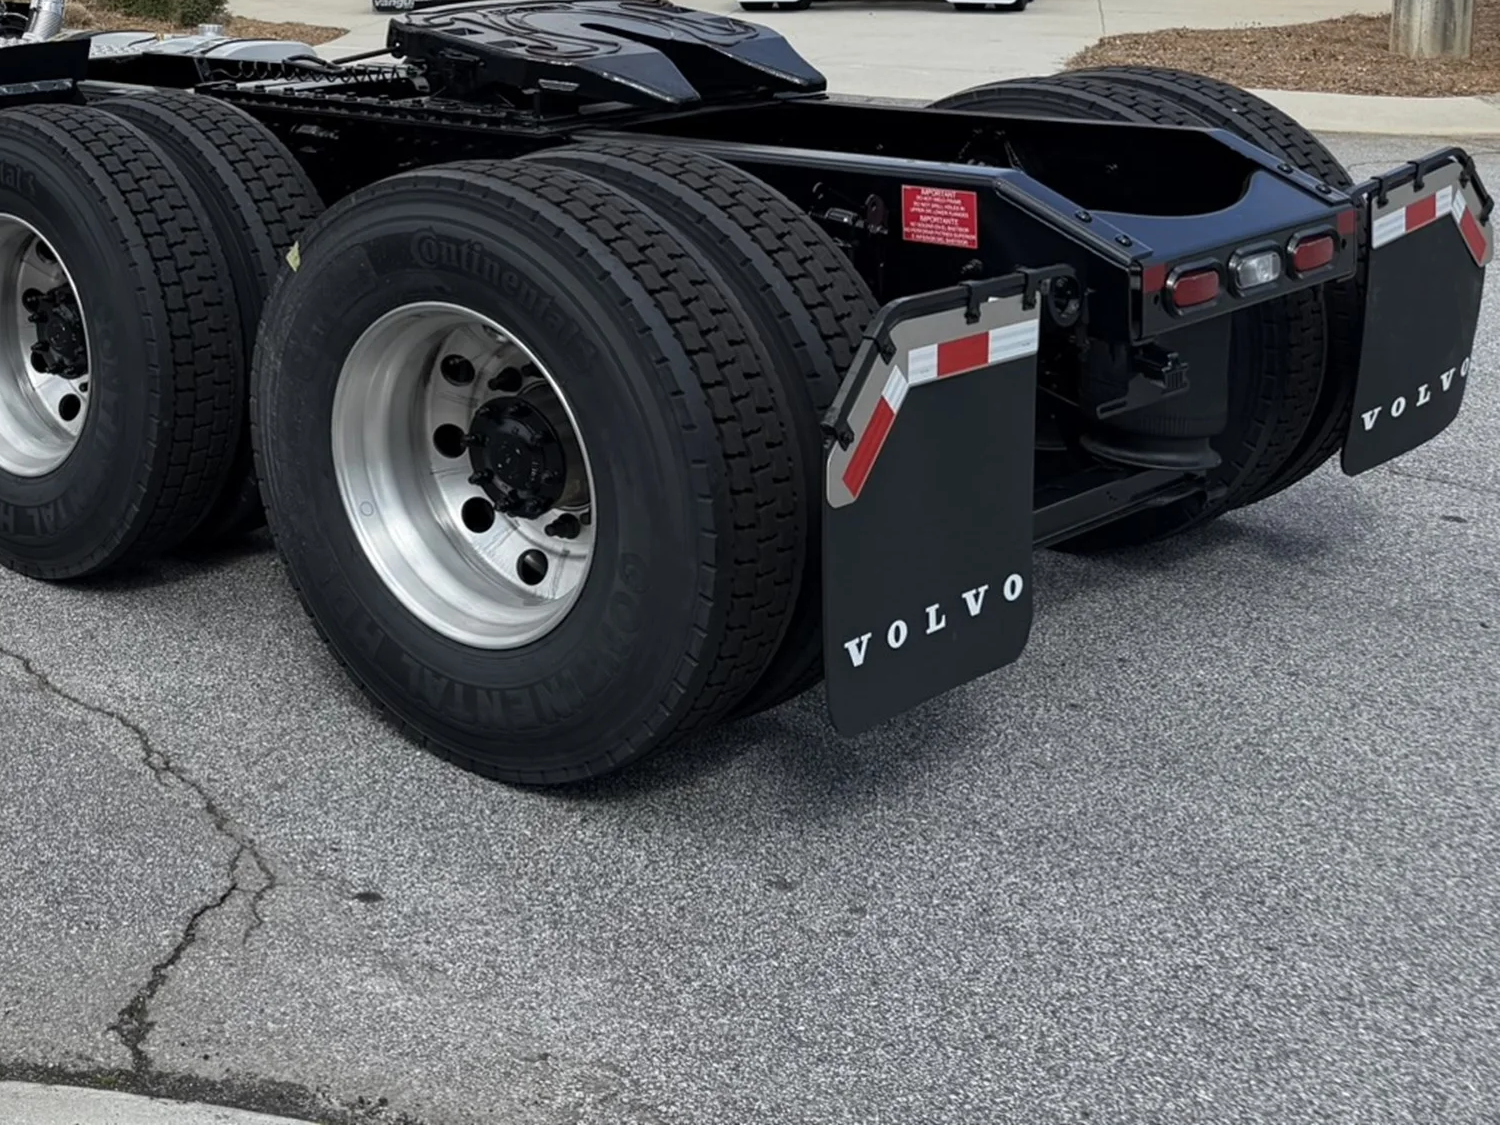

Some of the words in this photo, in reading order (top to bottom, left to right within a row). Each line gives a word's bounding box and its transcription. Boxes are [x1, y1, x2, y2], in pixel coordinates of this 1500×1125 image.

[921, 189, 956, 198] IMPORTANT
[410, 226, 584, 343] Continental
[1362, 357, 1469, 431] VOLVO
[844, 573, 1024, 667] VOLVO
